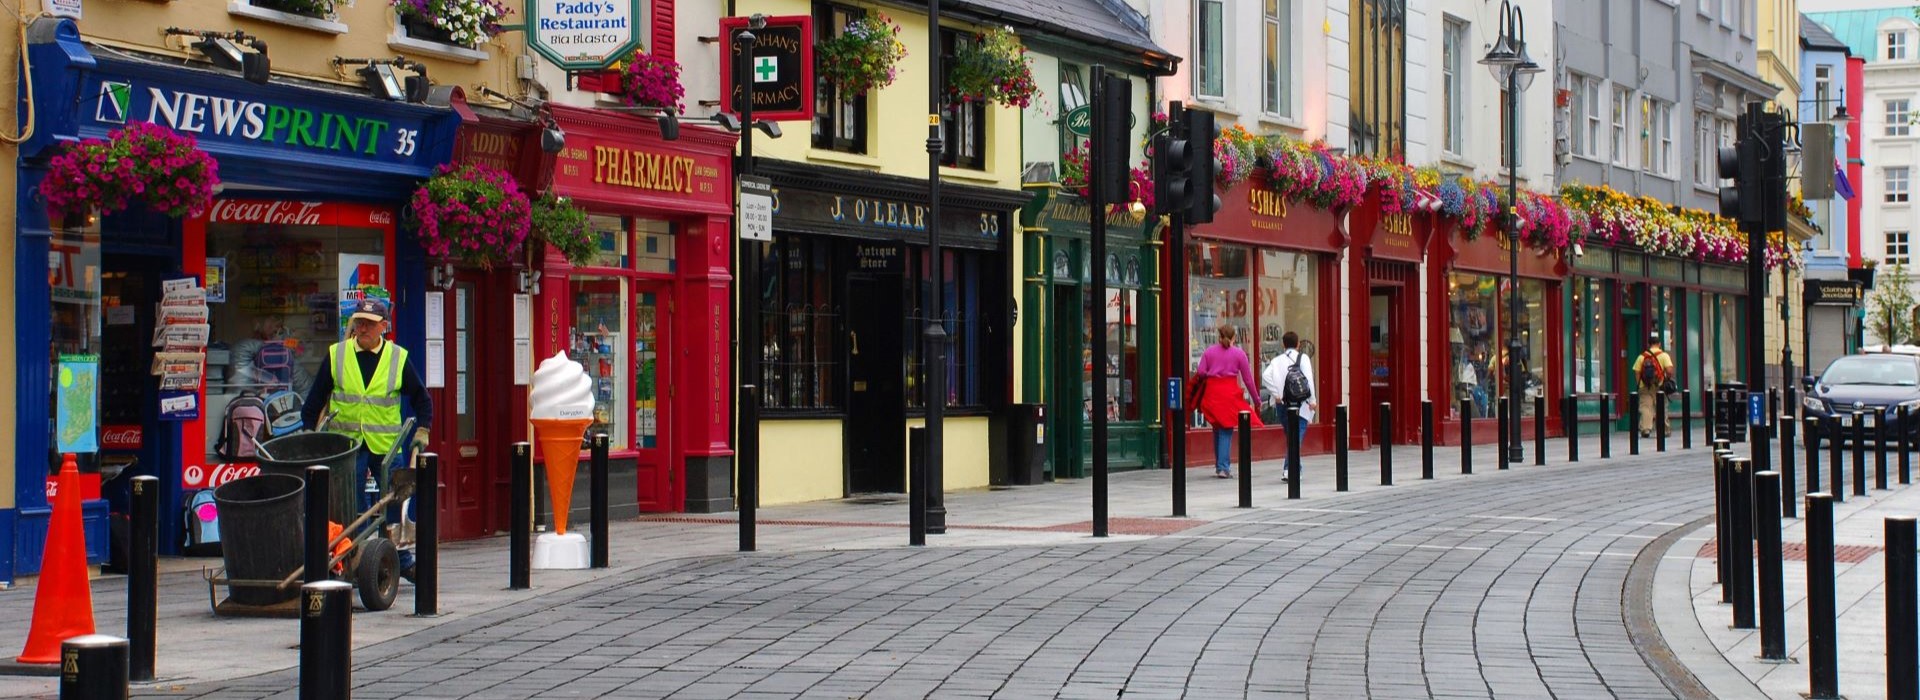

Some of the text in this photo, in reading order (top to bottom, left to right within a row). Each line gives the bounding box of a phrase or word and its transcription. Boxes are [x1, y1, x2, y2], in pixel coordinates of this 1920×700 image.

[556, 1, 614, 17] Paddy's
[540, 17, 627, 30] Restaurant
[573, 33, 617, 44] Blasta
[148, 87, 417, 157] NEWSPRINT 35
[595, 145, 695, 194] PHARMACY
[855, 199, 930, 230] O'LEAR
[980, 212, 1000, 237] 33
[856, 244, 897, 258] Antique
[860, 259, 888, 269] Store
